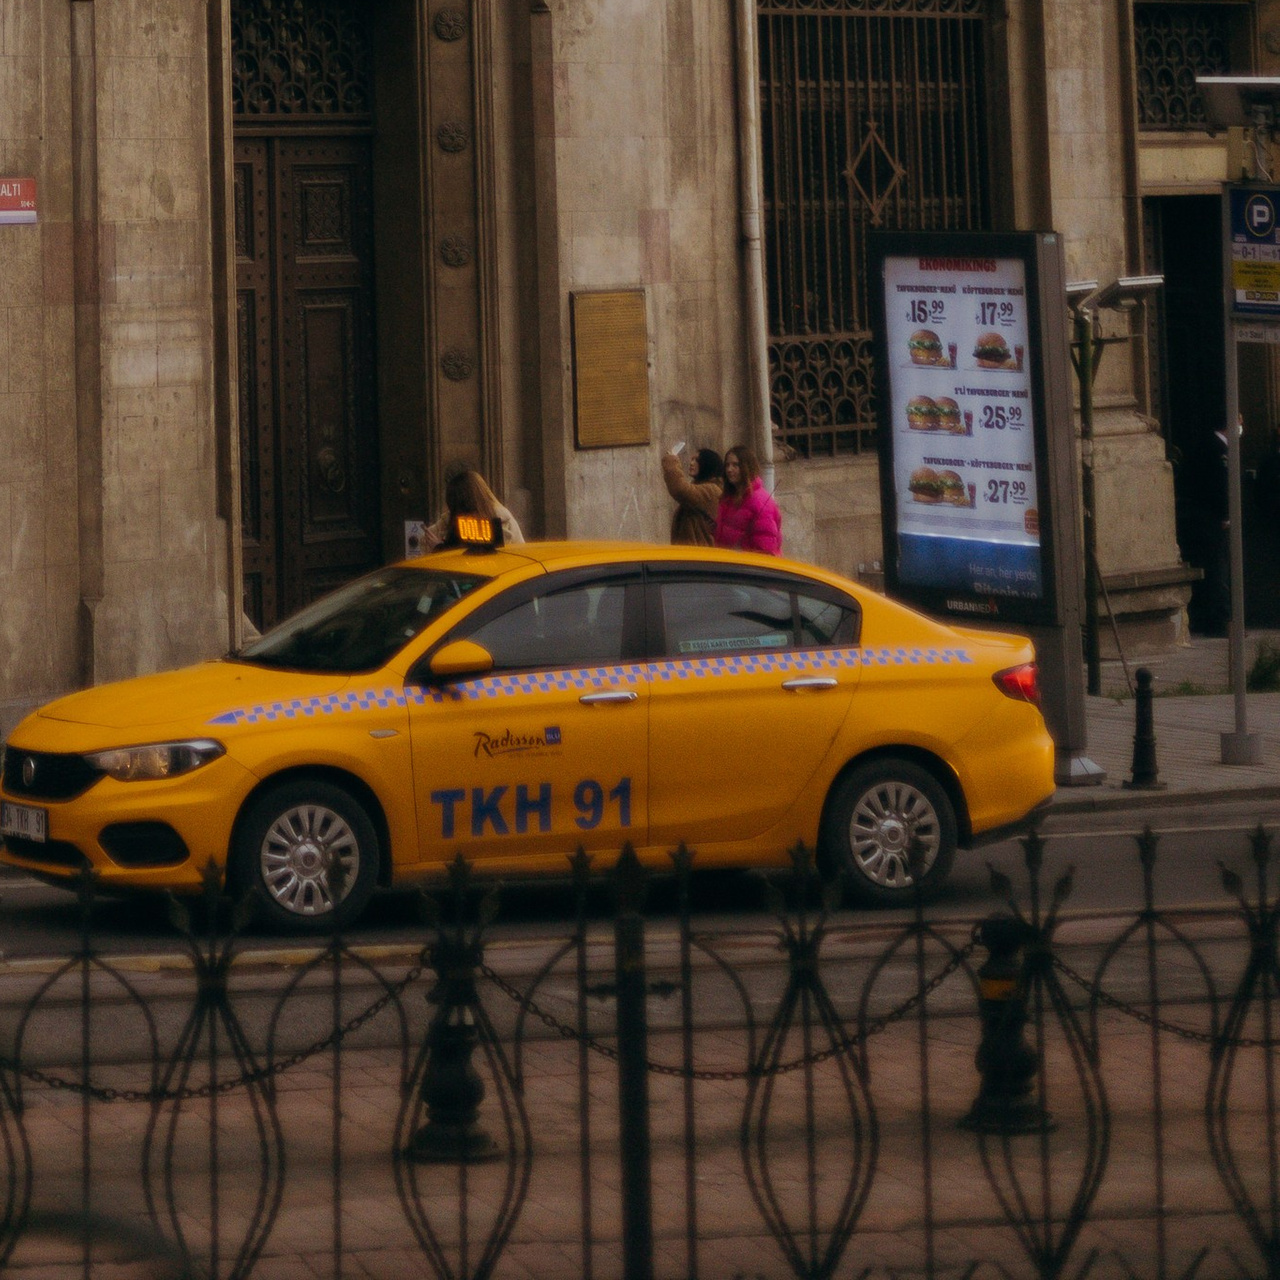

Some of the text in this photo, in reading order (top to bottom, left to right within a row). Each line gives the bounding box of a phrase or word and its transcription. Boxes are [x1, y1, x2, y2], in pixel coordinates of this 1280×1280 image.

[457, 515, 492, 542] DOLU
[473, 727, 545, 758] Radisson
[35, 811, 44, 834] 91
[430, 777, 632, 839] TKH 91
